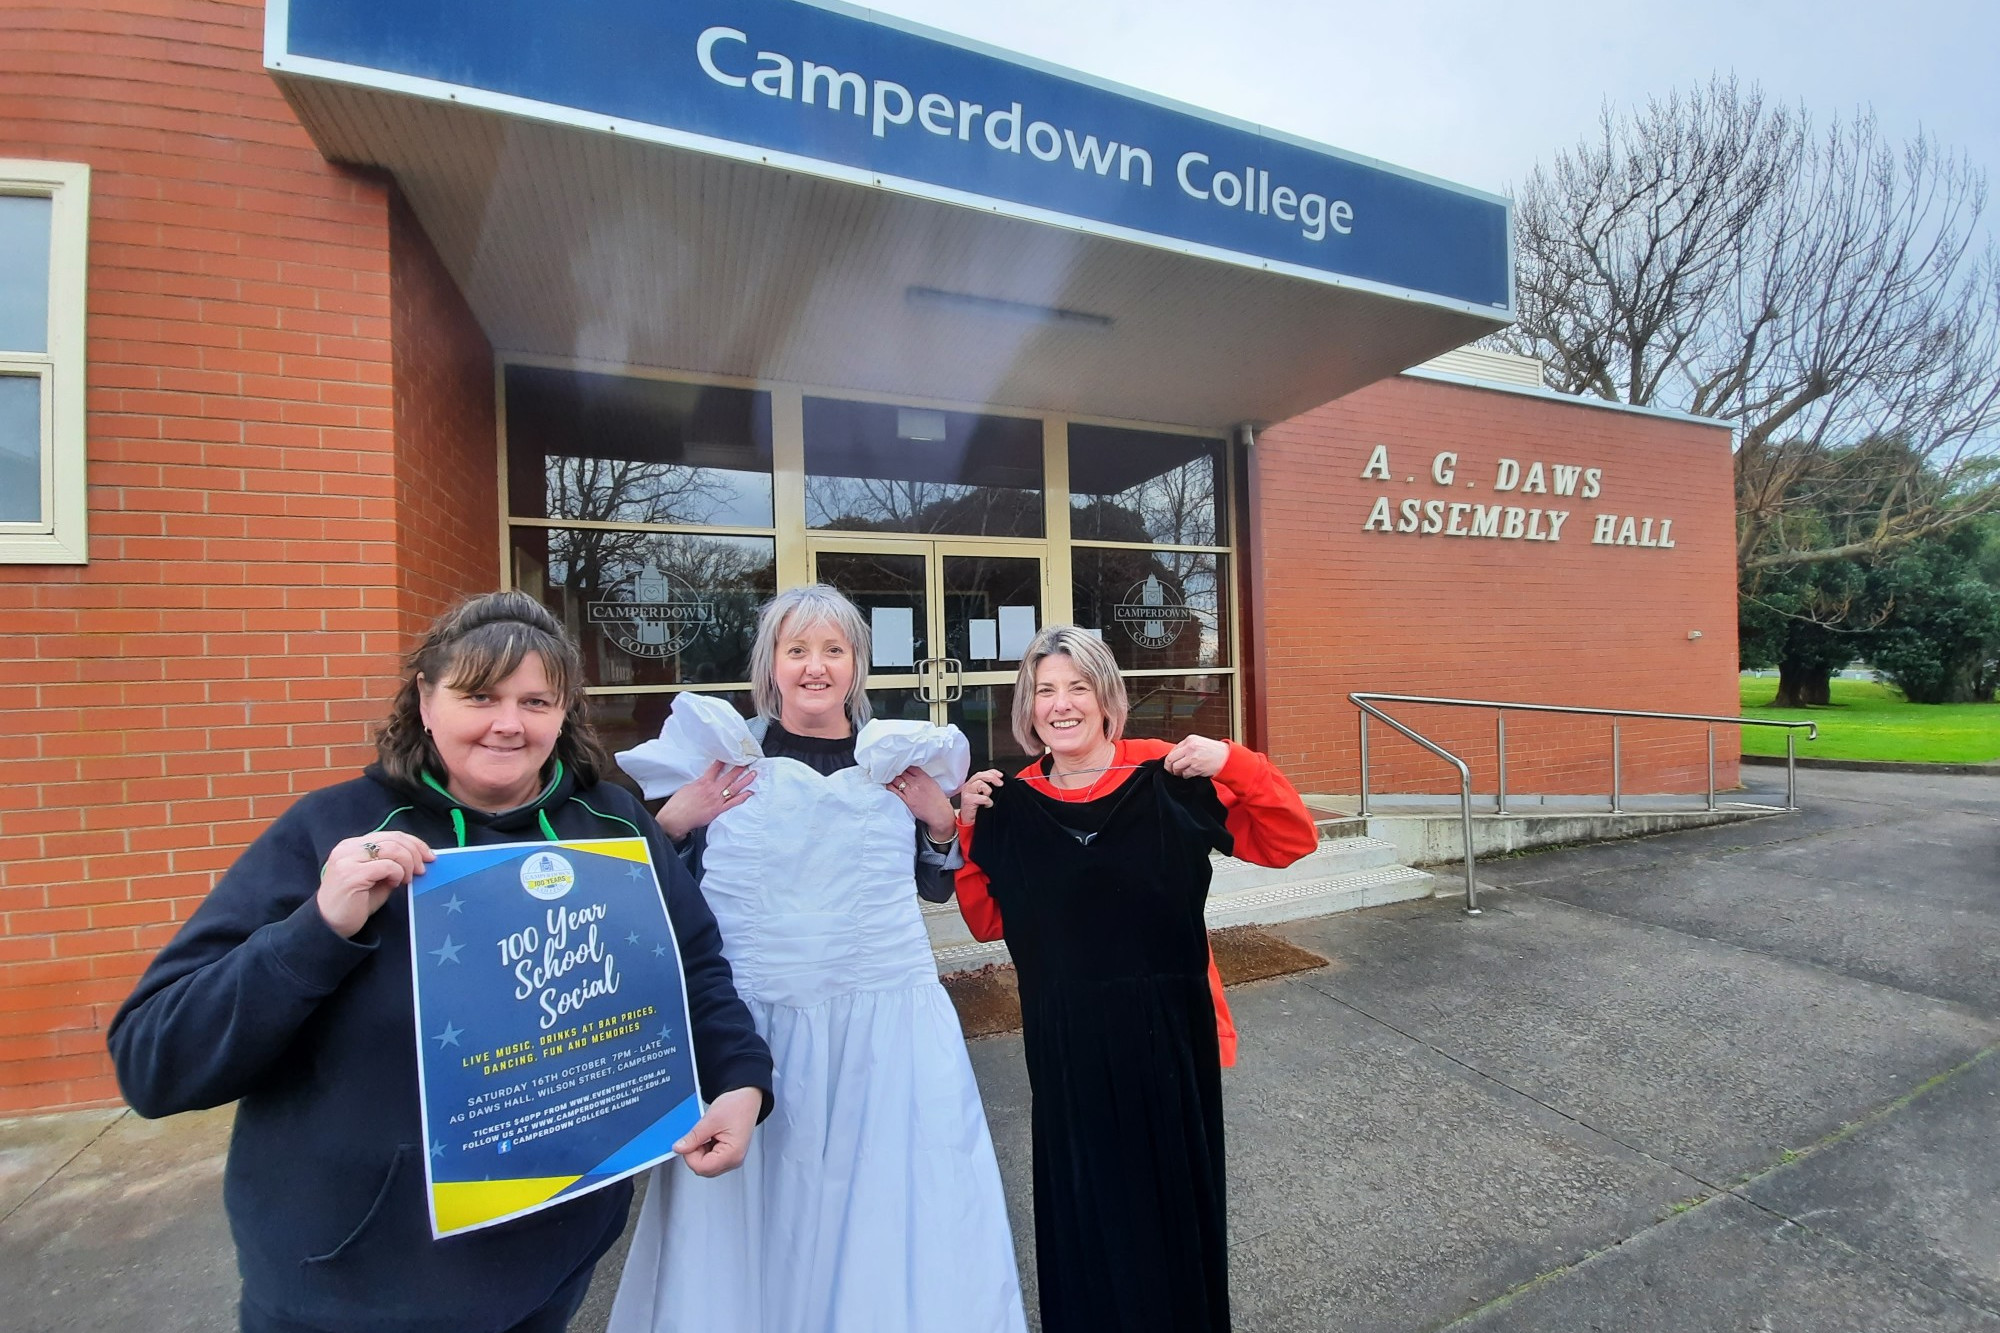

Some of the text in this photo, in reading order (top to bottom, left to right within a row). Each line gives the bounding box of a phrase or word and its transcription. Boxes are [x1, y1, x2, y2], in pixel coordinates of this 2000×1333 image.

[696, 26, 1354, 241] Camperdown College
[1493, 458, 1602, 499] DAWS
[1363, 496, 1676, 548] ASSEMBLY HALL
[592, 606, 709, 619] CAMPERDOWN
[1117, 608, 1188, 618] CAMPERDOWN
[618, 635, 689, 656] COLLEGE
[1133, 631, 1176, 647] COLLEGE
[497, 903, 606, 966] 100 Year
[515, 923, 604, 1000] School
[539, 954, 620, 1029] Social
[462, 1052, 489, 1067] LIVE
[540, 1027, 577, 1046] DRINKS
[582, 1023, 594, 1034] AT
[598, 1016, 617, 1029] BAR
[543, 1045, 563, 1058] FUN
[568, 1037, 587, 1050] AND
[591, 1022, 640, 1044] MEMORIES
[449, 1046, 677, 1124] AG DAWS HALL, WILSON STREET, CAMPERDOWN
[467, 1082, 528, 1107] SATURDAY
[532, 1072, 558, 1087] 16TH
[561, 1057, 607, 1078] OCTOBER
[611, 1049, 631, 1061] 7PM
[640, 1039, 662, 1053] LATE
[462, 1075, 671, 1151] FOLLOW US AT WWW.CAMPERDOWNCOLL.VIC.EDU.AU
[473, 1068, 666, 1137] TICKETS $40PP FROM WWW.EVENTBRITE.COM.AU
[512, 1120, 574, 1145] CAMPERDOWN
[576, 1106, 610, 1124] COLLEGE
[611, 1095, 640, 1111] ALUMNI
